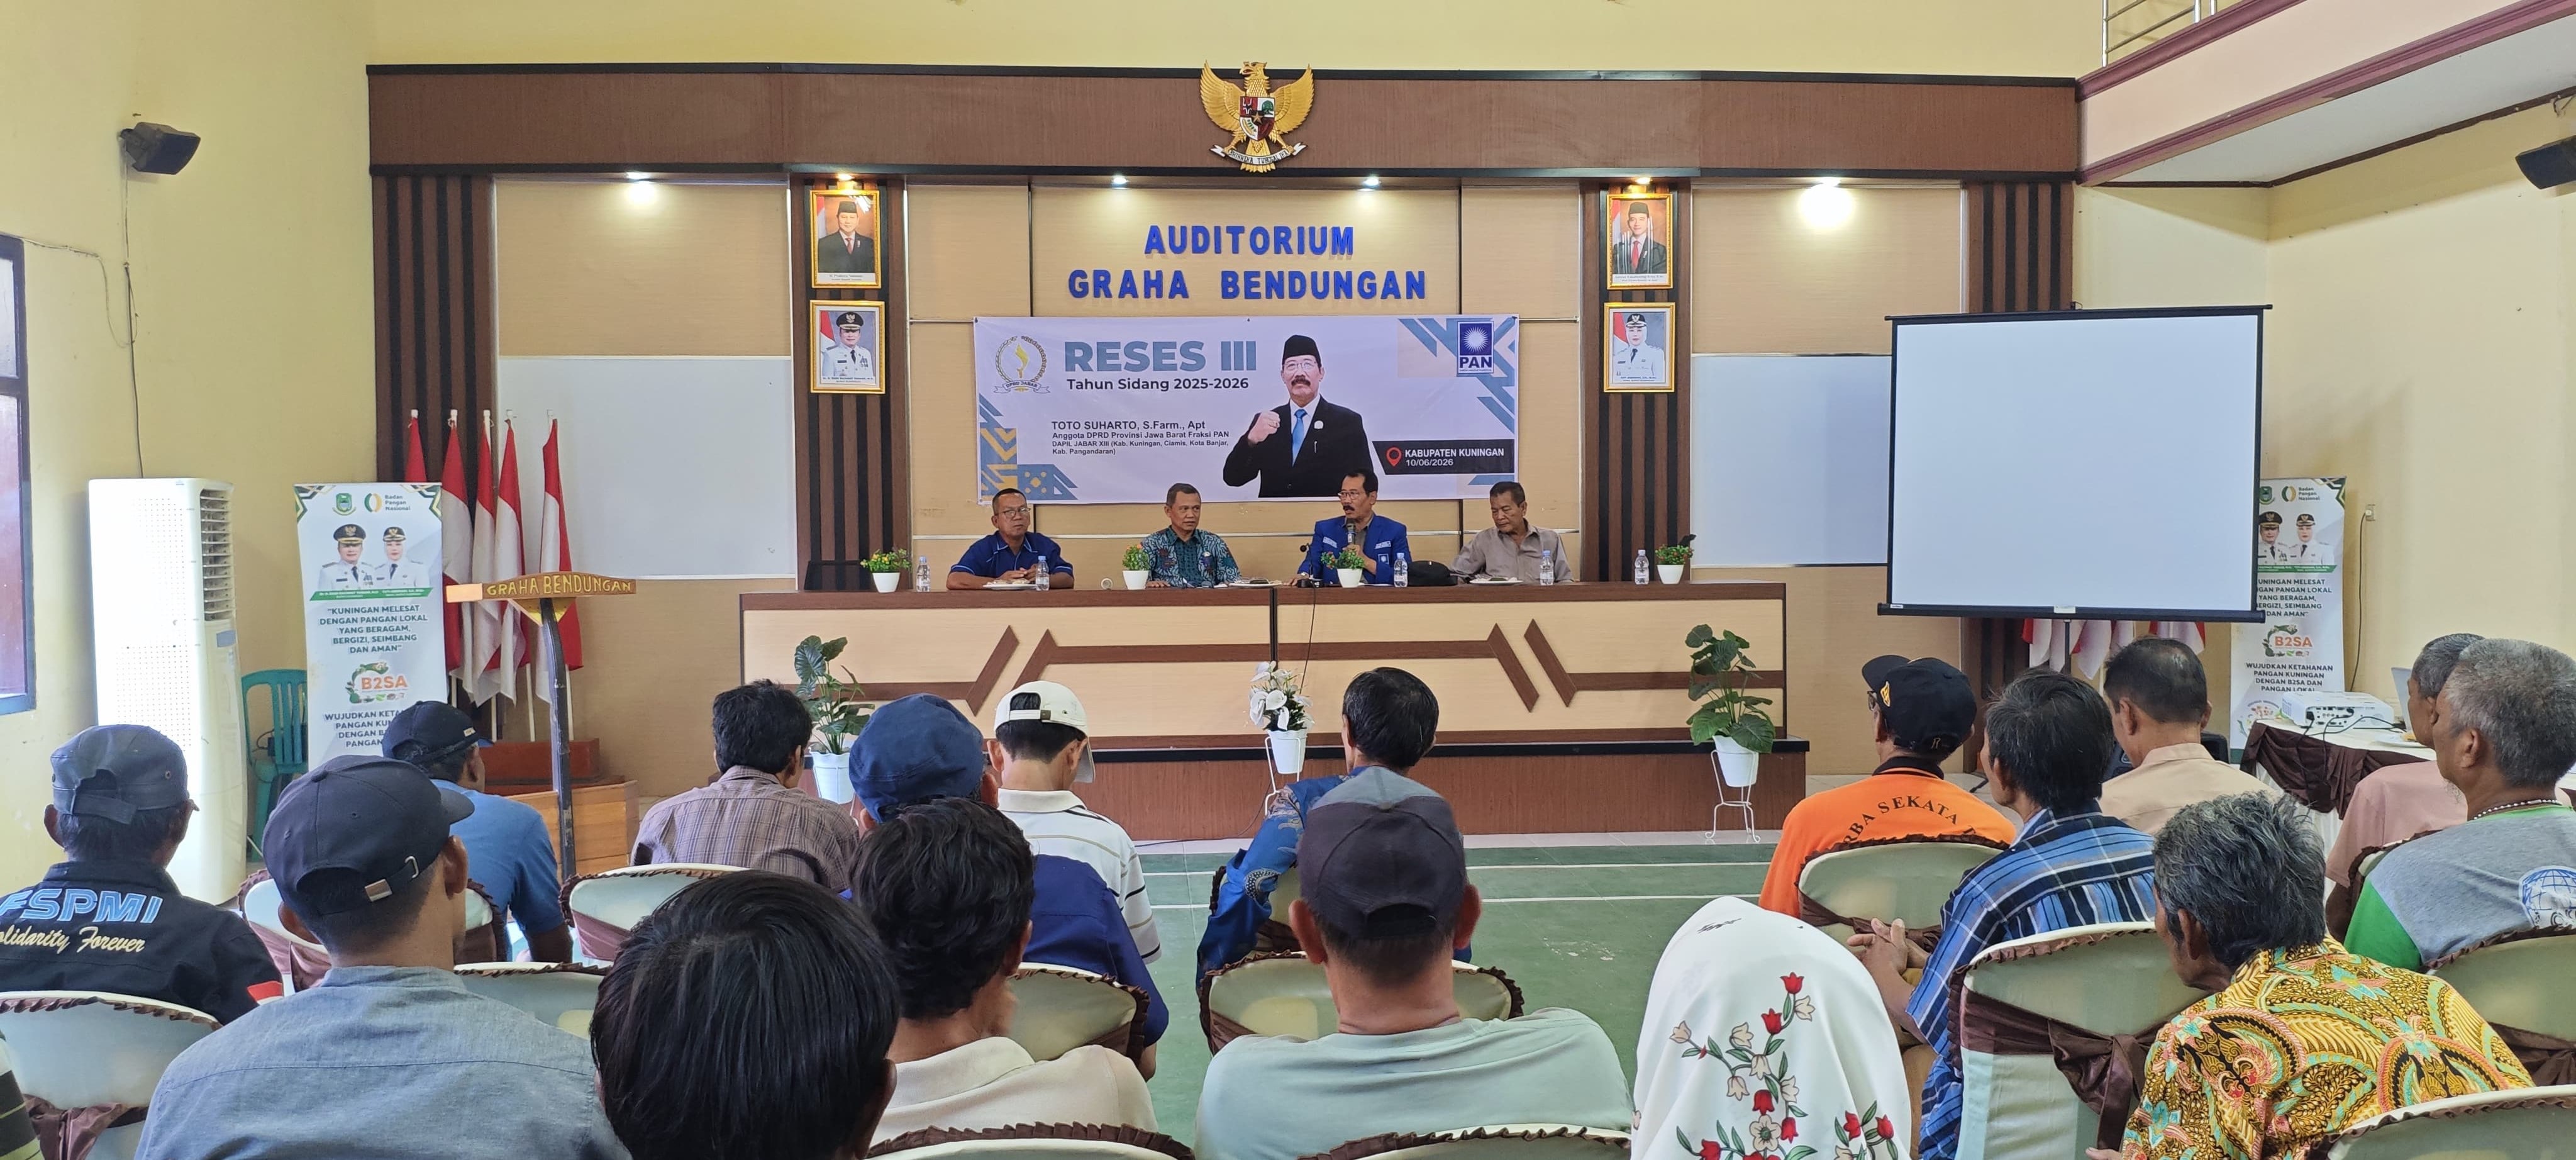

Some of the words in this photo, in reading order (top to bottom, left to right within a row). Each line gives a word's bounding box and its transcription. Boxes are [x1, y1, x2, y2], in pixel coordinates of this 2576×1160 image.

[1144, 225, 1353, 255] AUDITORIUM
[1069, 270, 1189, 298] GRAHA
[1221, 270, 1425, 299] BENDUNGAN
[1065, 340, 1206, 372] RESES
[1221, 341, 1257, 371] III
[1459, 357, 1492, 369] PAN
[1067, 378, 1113, 389] Tahun
[1118, 378, 1169, 392] Sidang
[1174, 377, 1249, 389] 2025-2026
[1052, 421, 1081, 430] TOTO
[1084, 421, 1140, 430] SUHARTO,
[1143, 420, 1185, 430] S.Farm.,
[1187, 420, 1206, 430] Apt
[1052, 432, 1085, 440] Anggota
[1404, 449, 1457, 457] KABUPATEN
[1458, 448, 1504, 457] KUNINGAN
[1406, 459, 1454, 467] 10/06/2026
[486, 577, 539, 596] GRAHA
[543, 574, 631, 594] BENDUNGAN
[381, 605, 420, 613] MELESAT
[360, 615, 397, 623] PANGAN
[399, 614, 428, 622] LOKAL
[365, 625, 411, 633] BERAGAM,
[333, 636, 370, 644] BERGIZI,
[372, 634, 417, 642] SEIMBANG
[2275, 636, 2313, 647] B2SA
[361, 675, 409, 690] B2SA
[325, 711, 377, 721] WUJUDKAN
[336, 721, 373, 729] PANGAN
[338, 730, 376, 739] DENGAN
[1843, 813, 1875, 844] RBA
[1878, 795, 1958, 825] SEKATA
[0, 888, 164, 923] FSPMI
[0, 923, 70, 954] olidarity
[77, 926, 145, 953] Forever
